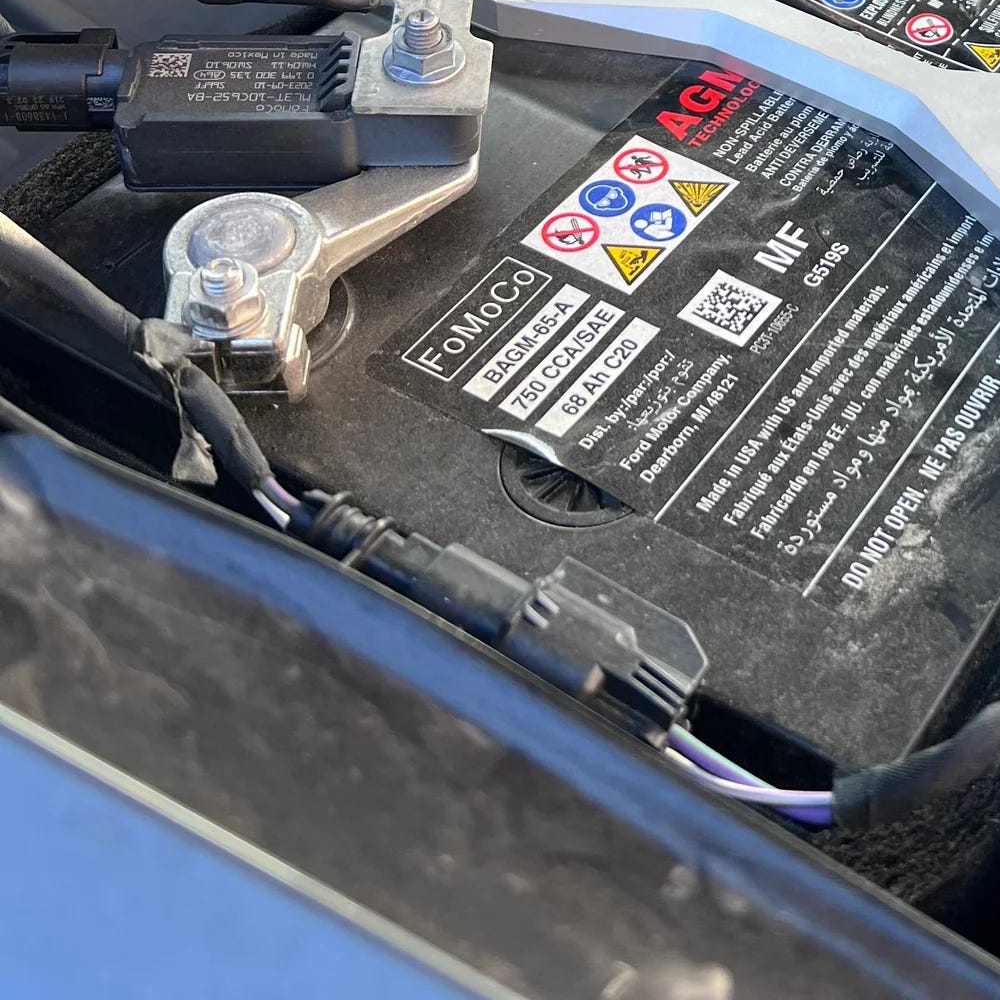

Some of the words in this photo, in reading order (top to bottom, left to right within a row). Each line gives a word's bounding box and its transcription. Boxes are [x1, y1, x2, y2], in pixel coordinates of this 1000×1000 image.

[227, 51, 269, 60] Mexico
[229, 70, 253, 80] 135
[255, 70, 278, 80] 300
[272, 51, 285, 60] in
[279, 70, 303, 80] 199
[290, 51, 319, 60] Made
[306, 70, 316, 80] 0
[186, 92, 312, 102] ML3T-10C652-BA
[253, 81, 314, 90] 2023-09-10
[255, 104, 310, 114] FoMoCo
[685, 79, 762, 149] TECHNOLOG
[725, 140, 754, 165] Lead
[748, 120, 773, 143] Acid
[766, 97, 796, 122] Batter
[744, 138, 783, 173] Batterie
[779, 126, 794, 139] au
[789, 105, 814, 128] plom
[761, 157, 785, 180] ANTI
[778, 111, 829, 159] DÉVERSEME
[779, 152, 817, 187] CONTRA
[810, 118, 846, 153] DERRAM
[815, 156, 829, 167] de
[824, 135, 848, 158] plomo
[843, 130, 854, 139] y
[847, 148, 868, 170] رصاص
[754, 221, 808, 273] MF
[940, 242, 955, 254] et
[945, 215, 976, 245] import
[803, 242, 849, 287] G519S
[901, 253, 946, 302] américains
[418, 270, 534, 371] FoMoCo
[749, 303, 799, 354] PC3T-10655-C
[863, 300, 907, 349] matériaux
[946, 286, 987, 328] المتحدة
[483, 302, 573, 383] BAGM-65-A
[510, 380, 547, 410] 750
[541, 309, 614, 379] CCA/SAE
[847, 348, 869, 369] des
[904, 326, 955, 383] الأمريكية
[561, 393, 587, 415] 68
[581, 371, 610, 396] Ah
[603, 338, 638, 369] C20
[671, 358, 694, 386] تقوم
[750, 475, 808, 539] Fabricardo
[802, 459, 820, 476] en
[811, 440, 834, 461] los
[825, 422, 849, 442] EE.
[840, 400, 866, 421] UU.
[860, 377, 881, 399] con
[875, 324, 922, 379] materiales
[916, 253, 979, 325] estadounidenses
[973, 245, 985, 254] e
[828, 367, 854, 395] avec
[618, 439, 652, 470] Ford
[645, 406, 681, 441] Motor
[676, 354, 732, 406] Company,
[695, 477, 731, 512] Made
[723, 463, 743, 478] in
[734, 438, 763, 465] USA
[757, 414, 783, 440] with
[774, 395, 796, 414] US
[791, 374, 813, 398] and
[805, 328, 850, 376] imported
[844, 285, 889, 331] materials.
[578, 424, 611, 450] Dist.
[639, 425, 699, 483] Dearborn,
[690, 404, 711, 423] MI
[706, 373, 739, 407] 48121
[780, 394, 834, 452] États-Unis
[856, 419, 890, 446] منها
[767, 450, 790, 474] aux
[832, 449, 874, 489] ومواد
[723, 471, 772, 526] Fabriqué
[841, 561, 872, 589] DO
[859, 526, 894, 564] NOT
[884, 486, 928, 530] OPEN.
[918, 455, 946, 480] NE
[933, 427, 965, 459] PAS
[776, 491, 837, 555] مستوردة
